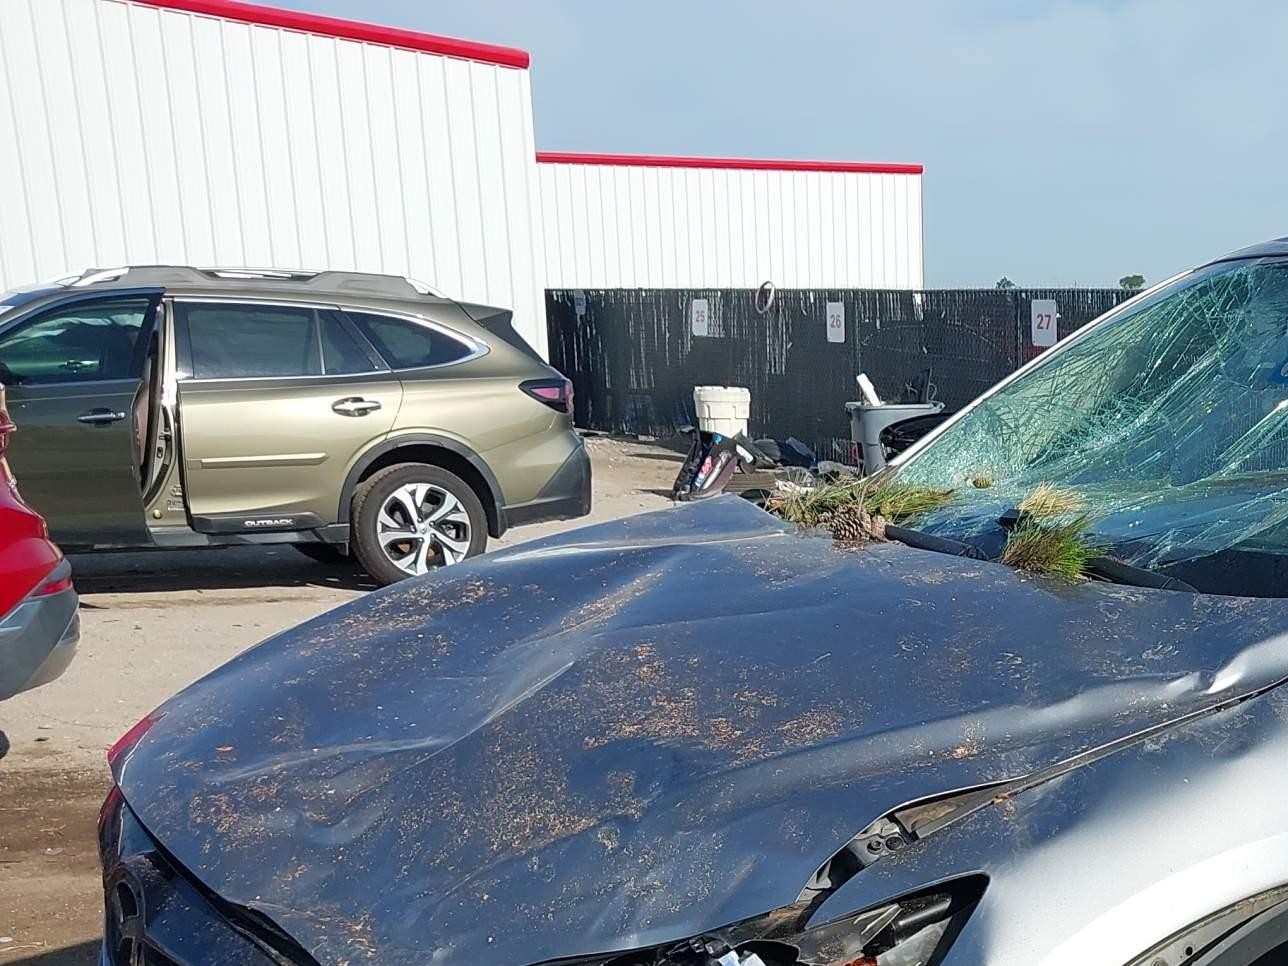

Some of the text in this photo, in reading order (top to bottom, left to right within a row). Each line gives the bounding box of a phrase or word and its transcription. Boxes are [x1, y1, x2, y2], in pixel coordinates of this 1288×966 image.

[695, 310, 705, 323] 25
[830, 314, 842, 328] 26
[1037, 313, 1051, 330] 27
[244, 519, 293, 527] OUTBACK
